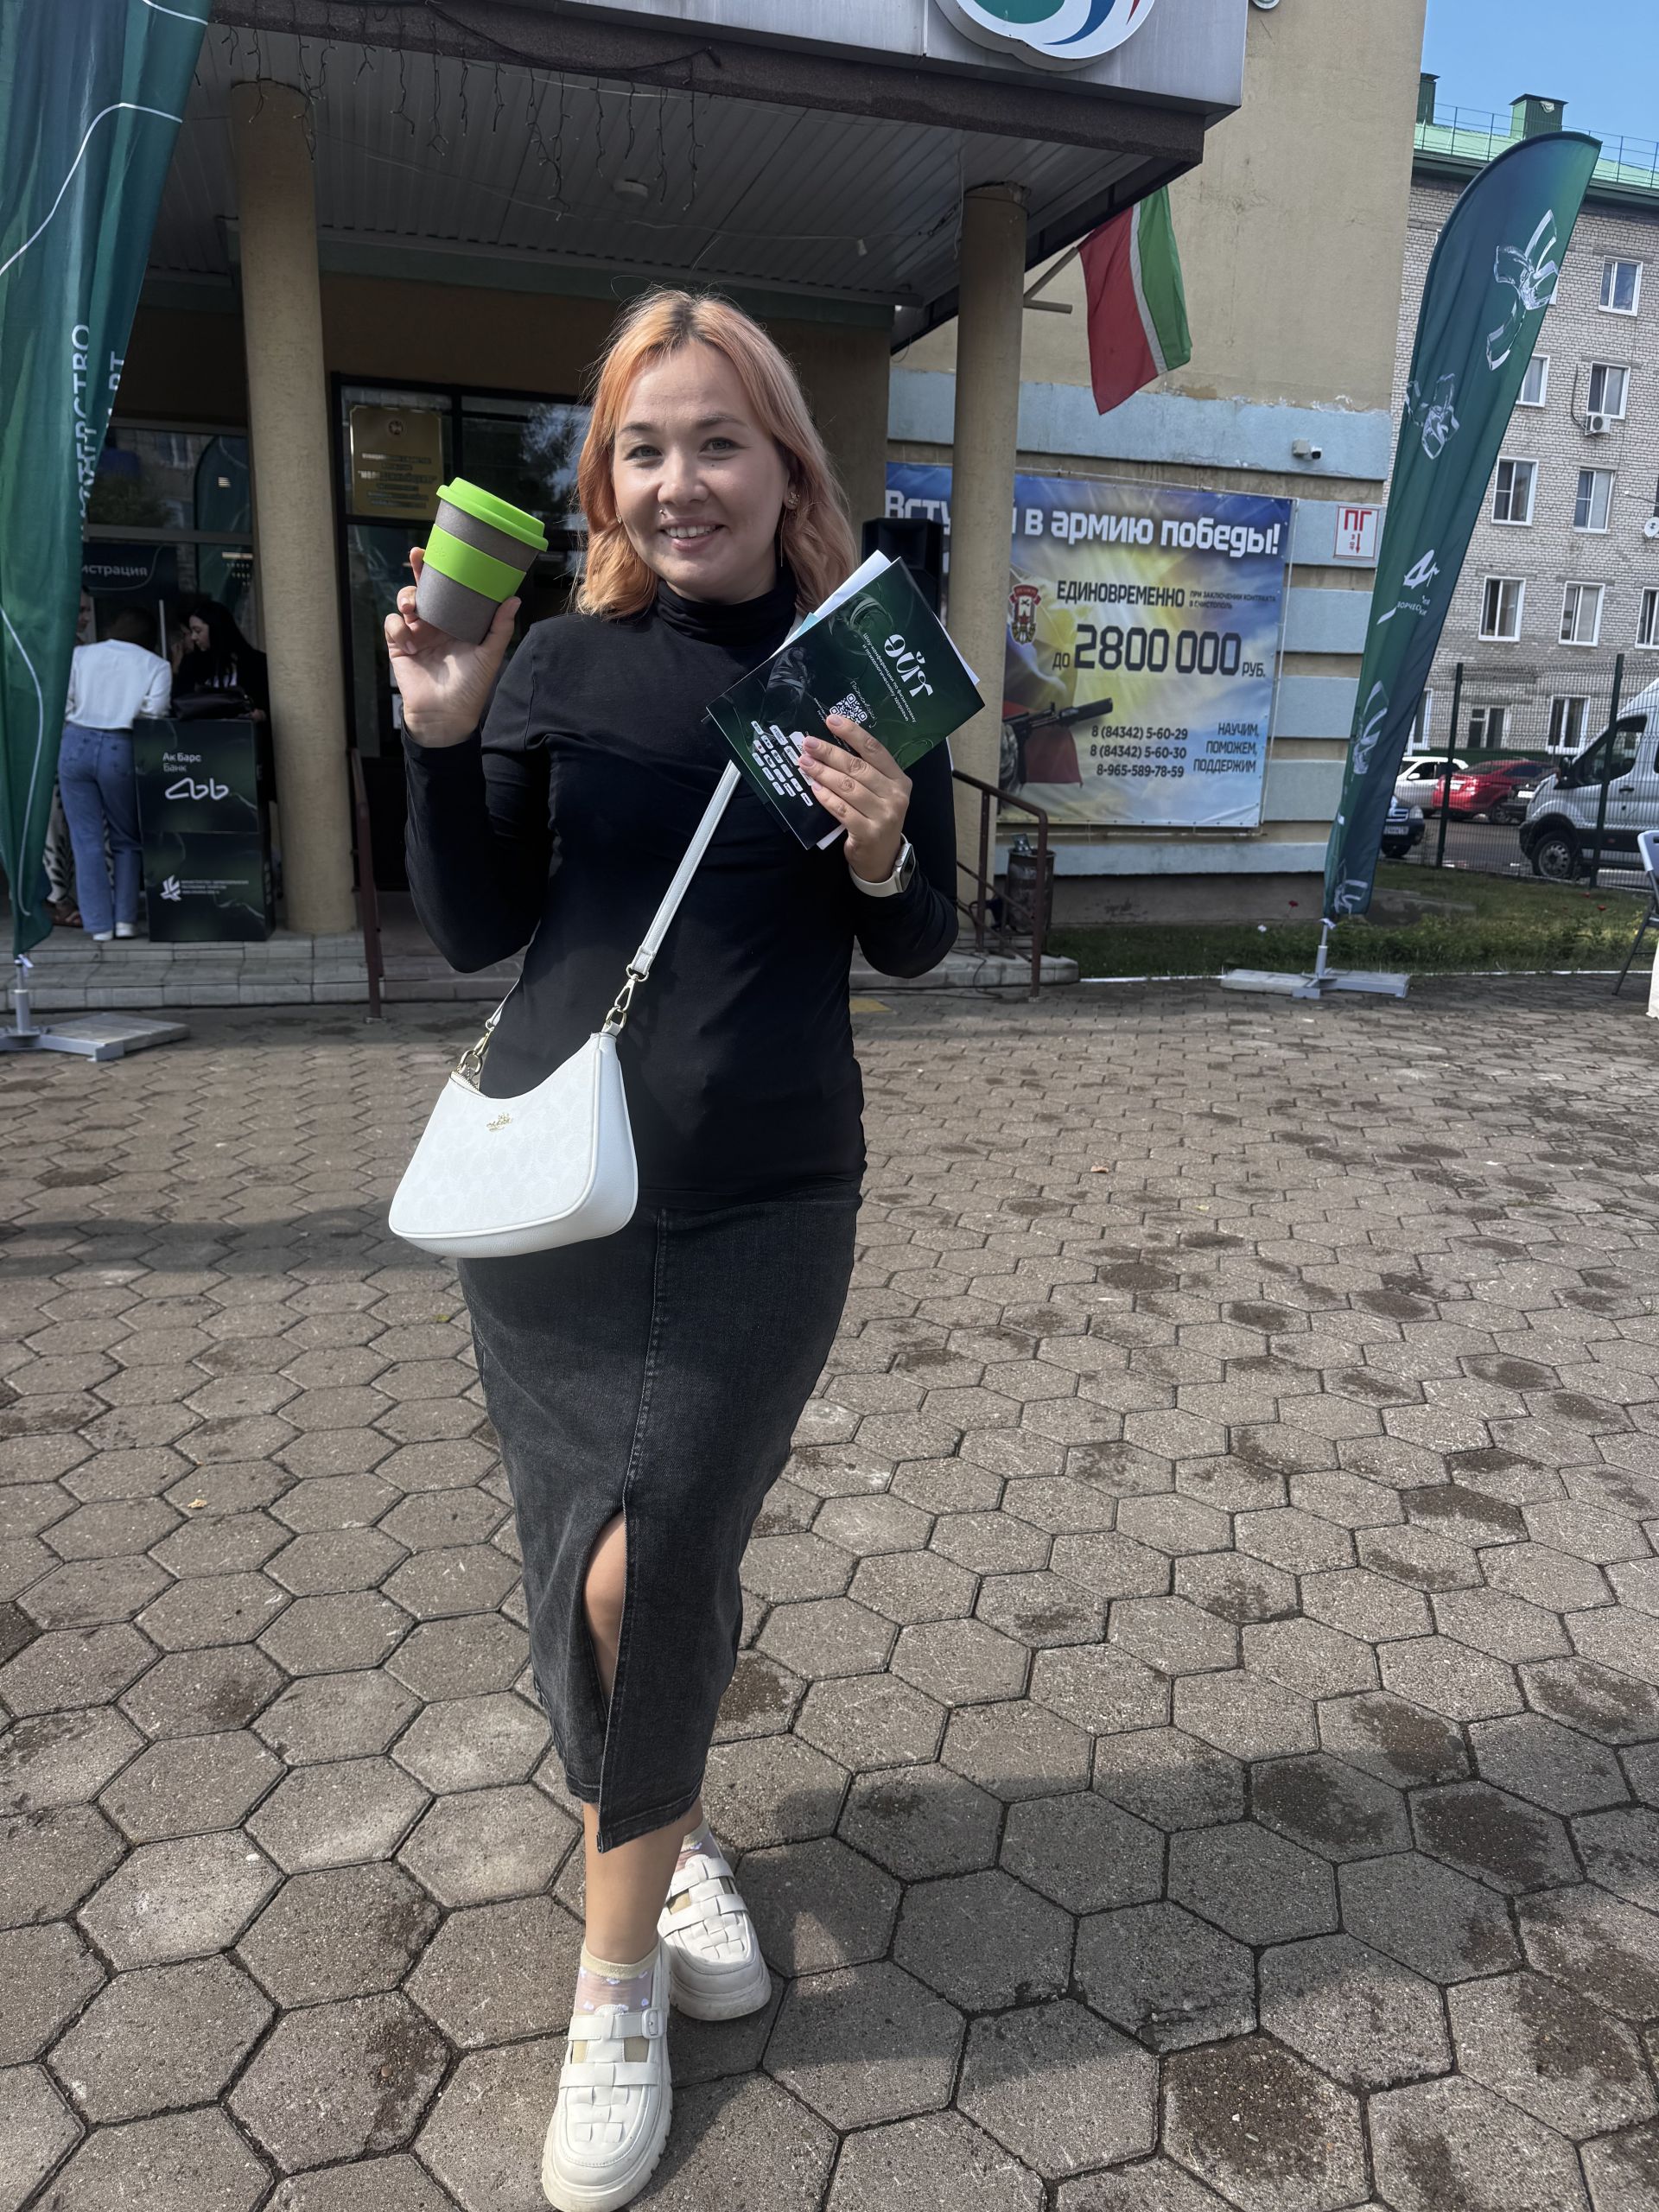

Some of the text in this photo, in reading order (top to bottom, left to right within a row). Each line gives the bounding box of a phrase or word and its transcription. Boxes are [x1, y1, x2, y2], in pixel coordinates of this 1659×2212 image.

[1344, 509, 1372, 531] ПГ
[1051, 511, 1154, 545] армию
[1160, 517, 1281, 558] победы!
[1057, 580, 1185, 608] ЕДИНОВРЕМЕННО
[1242, 662, 1266, 677] РУБ.
[1091, 725, 1188, 741] 8 (84342) 5-60-29
[1217, 722, 1259, 737] НАУЧИМ,
[1090, 745, 1186, 760] 8 (84342) 5-60-30
[1206, 741, 1257, 756] ПОМОЖЕМ,
[162, 752, 201, 762] Ак Барс
[163, 763, 188, 772] Банк
[1096, 764, 1184, 778] 8-965-589-78-59
[1193, 759, 1256, 774] ПОДДЕРЖИМ
